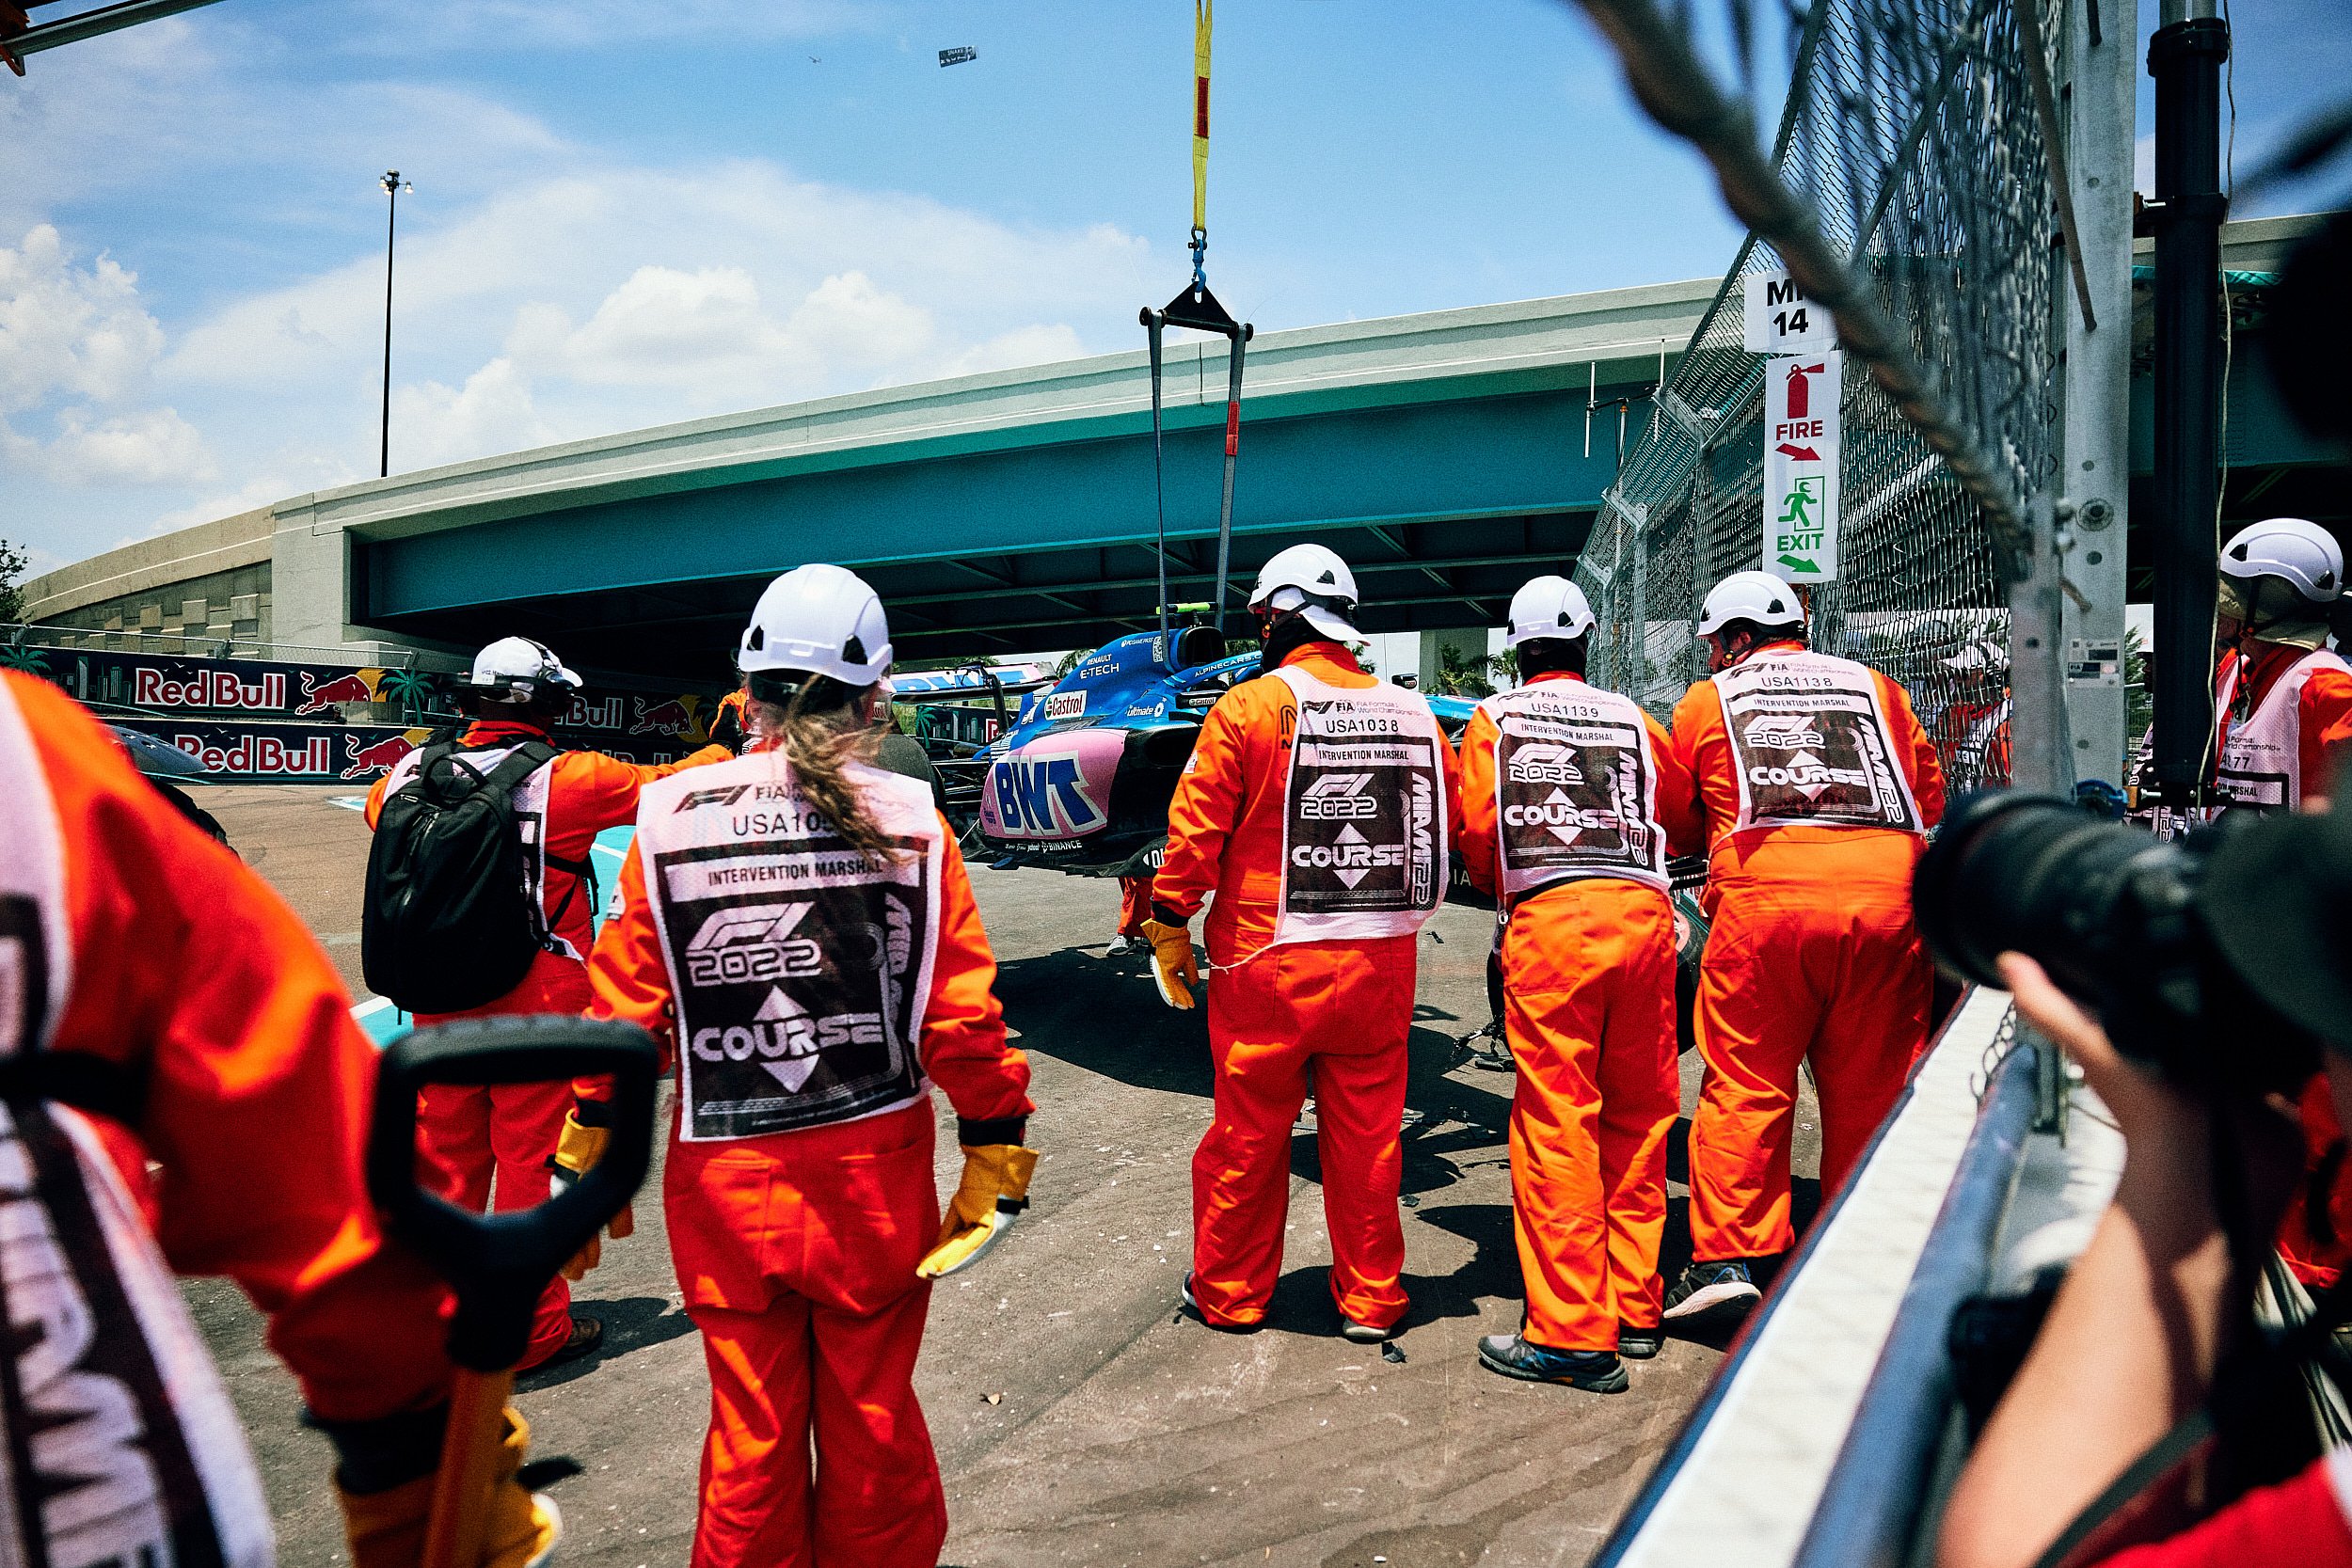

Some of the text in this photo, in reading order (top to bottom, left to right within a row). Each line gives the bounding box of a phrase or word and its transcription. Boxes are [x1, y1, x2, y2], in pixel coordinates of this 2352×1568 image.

[1772, 308, 1809, 337] 14
[1775, 420, 1823, 442] FIRE
[1776, 532, 1825, 552] EXIT
[1087, 654, 1112, 666] RENAULT
[1770, 663, 1788, 672] FIA
[1080, 662, 1120, 679] E-TECH
[1761, 676, 1833, 688] USA1138
[1053, 694, 1084, 717] Castrol
[1336, 701, 1355, 713] FIA
[1531, 702, 1599, 718] USA1139
[1754, 698, 1851, 707] INTERVENTION MARSHAL
[1326, 719, 1399, 734] USA1038
[1520, 723, 1614, 741] INTERVENTION MARSHAL
[1744, 730, 1826, 750] 2022
[1318, 750, 1409, 761] INTERVENTION MARSHAL
[1508, 762, 1585, 785] 2022
[1749, 766, 1868, 787] COURSE
[755, 784, 788, 801] FIA
[993, 753, 1105, 833] BWT
[1300, 796, 1378, 820] 2022
[1504, 804, 1620, 830] COURSE
[1049, 840, 1083, 851] BINANCE
[1291, 844, 1405, 867] COURSE
[708, 862, 810, 887] INTERVENTION
[1448, 868, 1471, 887] IA
[685, 938, 823, 988] 2022
[691, 1012, 883, 1062] COURSE
